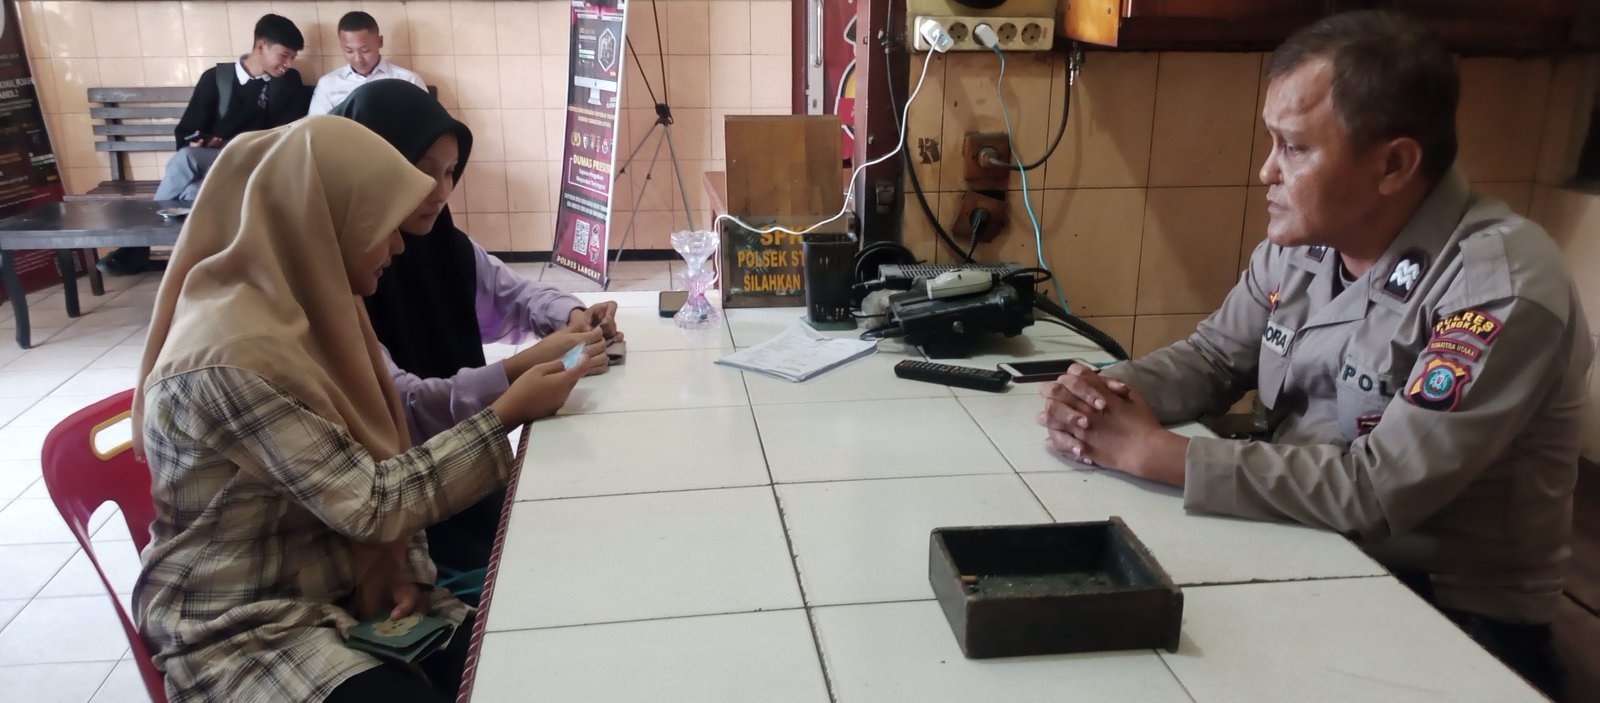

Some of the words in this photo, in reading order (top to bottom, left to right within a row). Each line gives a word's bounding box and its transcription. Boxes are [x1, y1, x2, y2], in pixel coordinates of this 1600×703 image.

[573, 154, 593, 169] DUMAS
[556, 255, 577, 270] POLRES
[577, 263, 601, 281] LANGKAT
[737, 249, 788, 268] POLSEK
[791, 250, 805, 268] ST
[743, 274, 801, 292] SILAHKAN
[1436, 312, 1495, 332] POLRES
[1440, 321, 1482, 335] LANGKAT
[1264, 326, 1288, 349] ORA
[1431, 341, 1456, 350] SUMATERA
[1456, 344, 1475, 356] UTARA
[1342, 364, 1398, 398] POL
